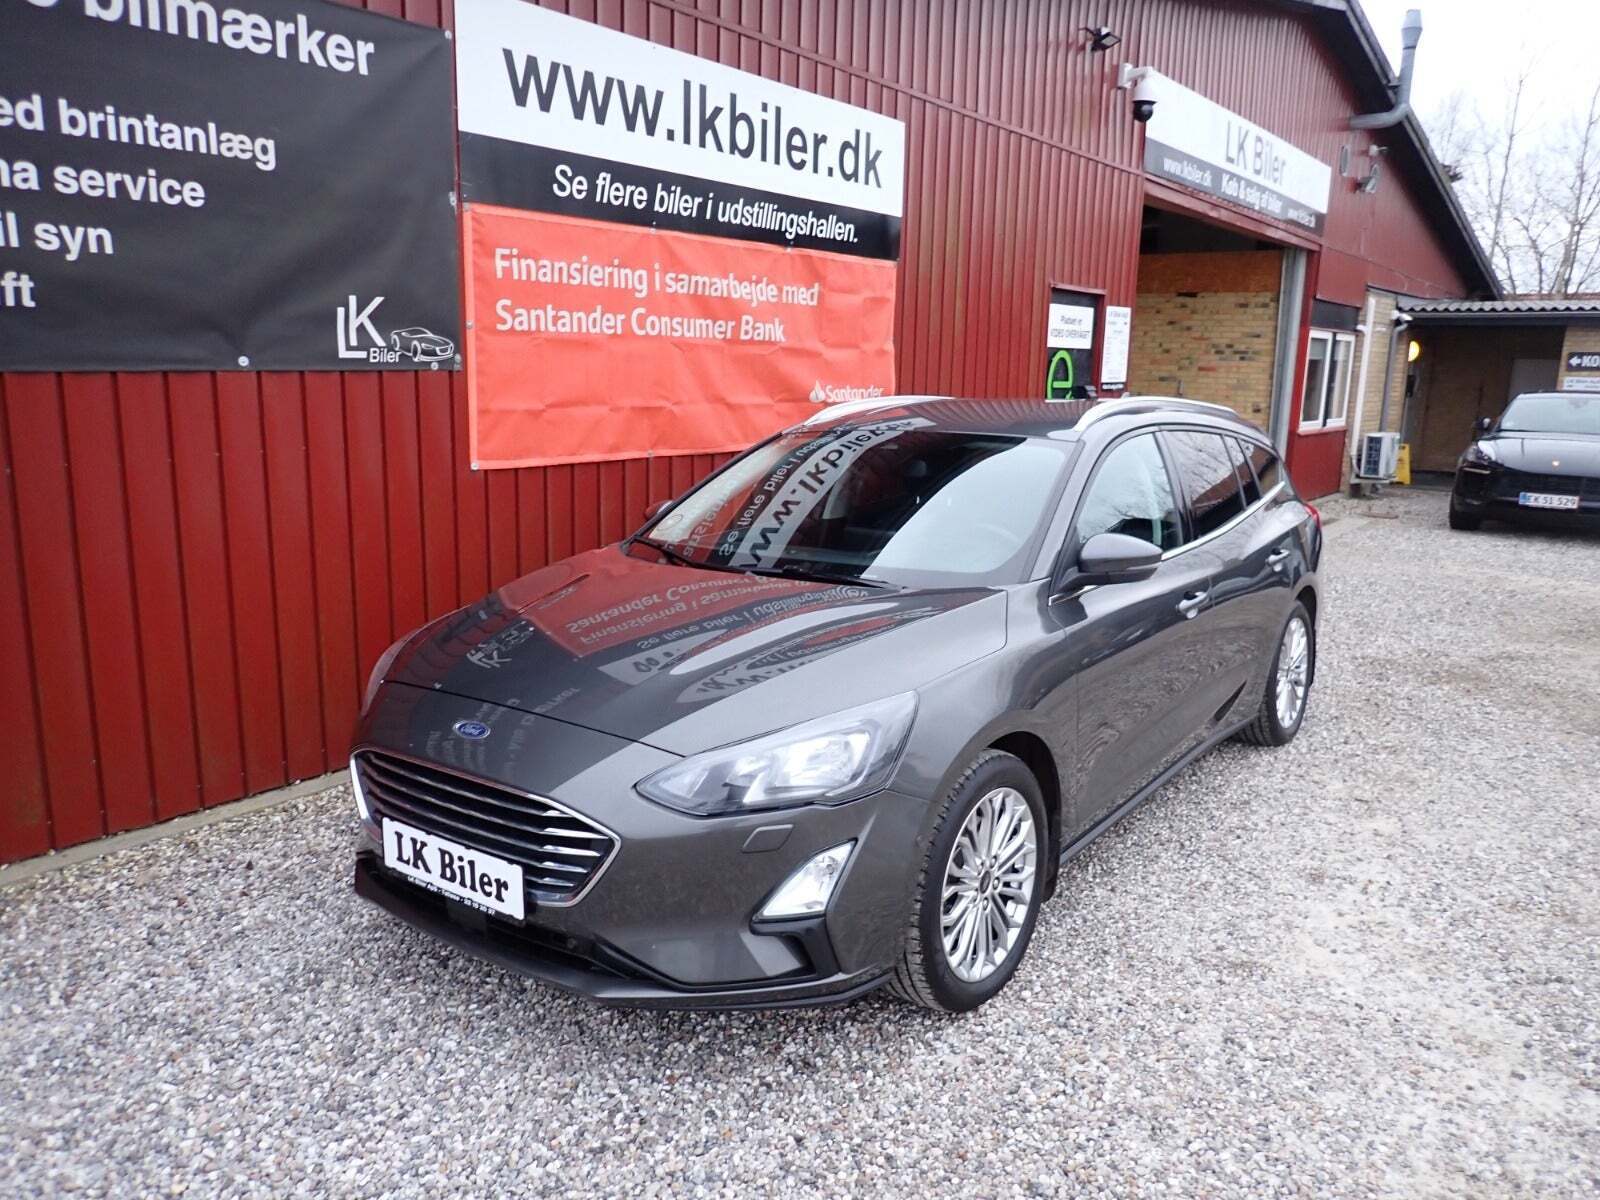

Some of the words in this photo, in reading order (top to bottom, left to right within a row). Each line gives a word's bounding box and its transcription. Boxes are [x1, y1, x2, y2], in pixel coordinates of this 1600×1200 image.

[58, 98, 277, 171] brintanlæg
[502, 47, 883, 189] www.lkbiler.dk
[53, 166, 206, 207] service
[1225, 119, 1250, 174] LK
[1252, 134, 1287, 188] Biler
[552, 164, 588, 199] Se
[596, 172, 648, 209] flere
[654, 182, 702, 219] biler
[705, 192, 713, 219] i
[717, 203, 859, 244] udstillingshallen.
[34, 222, 114, 261] syn
[495, 247, 648, 298] Finansiering
[655, 262, 661, 291] i
[664, 271, 778, 307] samarbejde
[782, 285, 820, 307] med
[336, 295, 387, 359] LK
[369, 347, 401, 363] Biler
[495, 299, 625, 335] Santander
[631, 307, 735, 340] Consumer
[740, 315, 787, 343] Bank
[825, 384, 885, 402] Santander
[395, 831, 432, 875] LK
[438, 847, 509, 903] Biler
